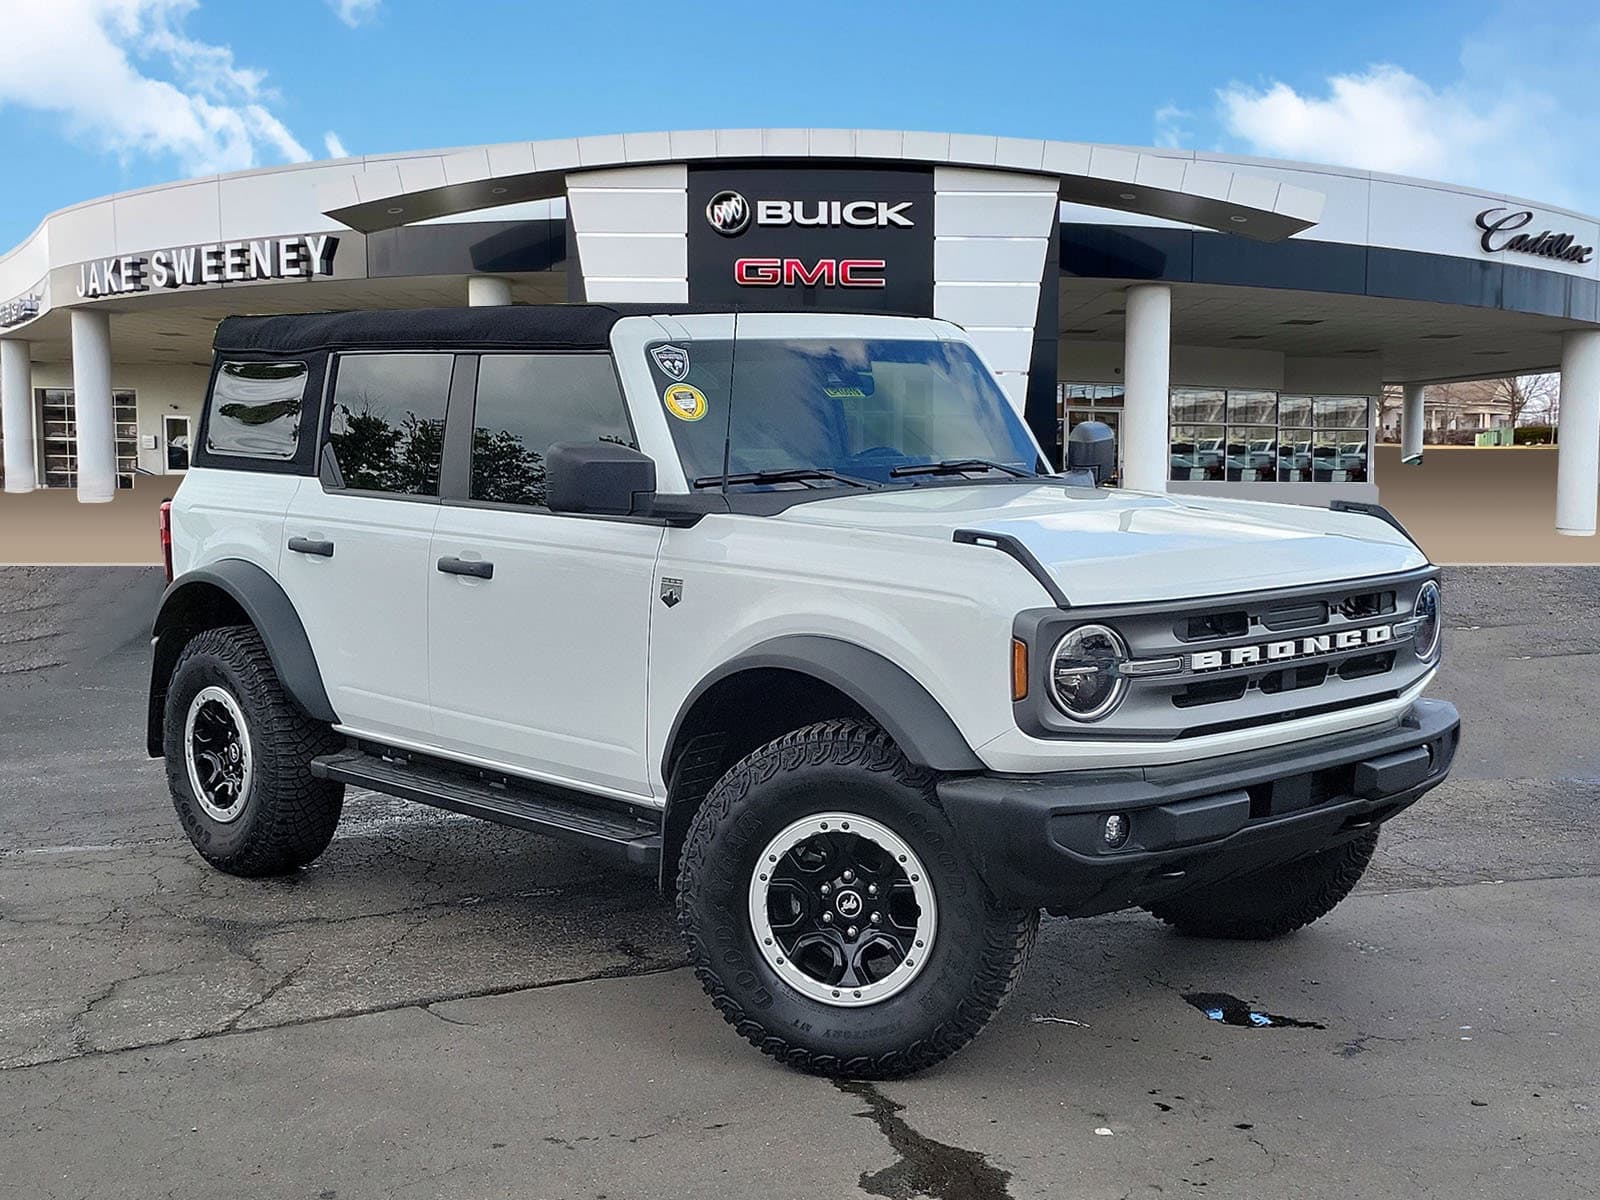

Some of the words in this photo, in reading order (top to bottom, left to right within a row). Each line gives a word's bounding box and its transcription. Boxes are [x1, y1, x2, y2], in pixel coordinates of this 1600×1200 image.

[757, 200, 915, 226] BUICK
[1475, 207, 1593, 263] Cadillac
[76, 256, 140, 298] JAKE
[151, 234, 335, 288] SWEENEY
[734, 257, 886, 286] GMC
[1191, 625, 1391, 671] BRONCO
